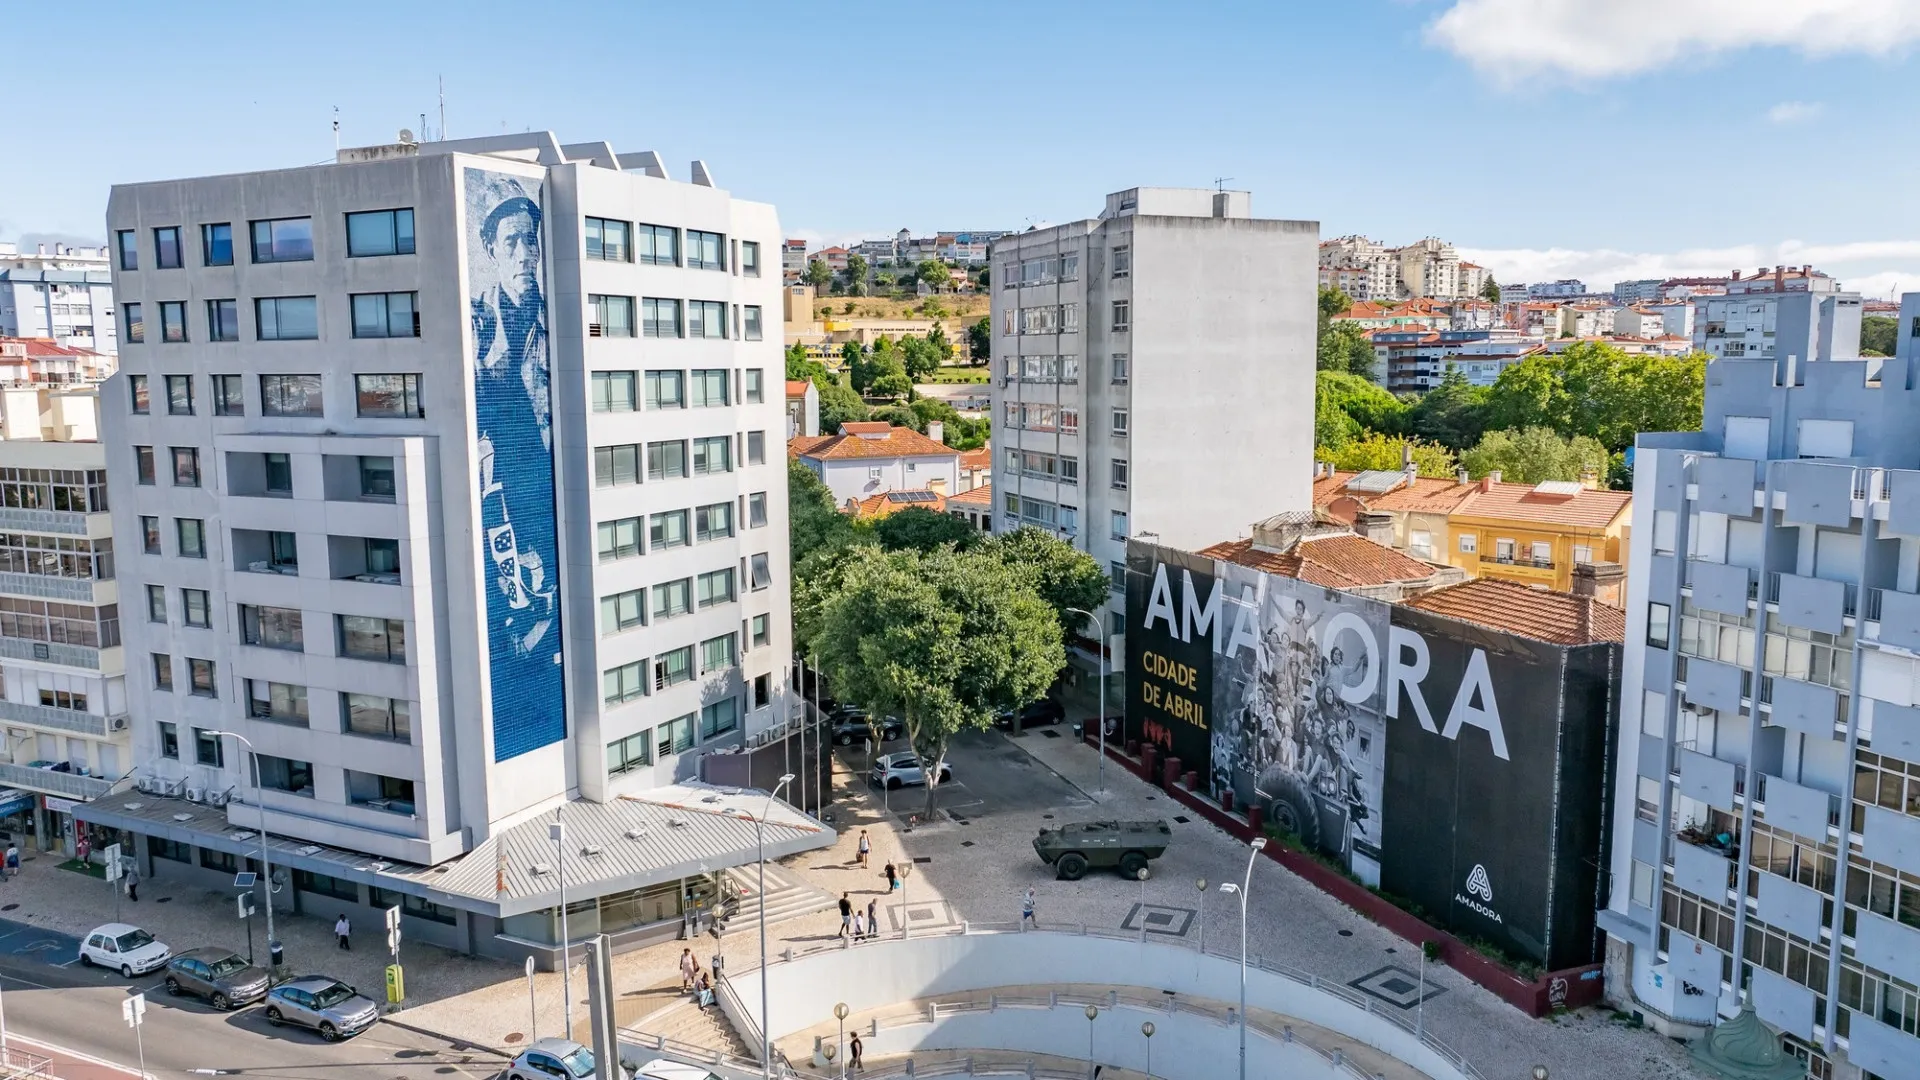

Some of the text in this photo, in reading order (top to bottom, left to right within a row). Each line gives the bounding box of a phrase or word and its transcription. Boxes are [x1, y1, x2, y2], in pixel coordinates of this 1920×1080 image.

[1143, 651, 1197, 692] CIDADE
[1144, 563, 1510, 761] AMAORA
[1143, 681, 1208, 729] DE ABRIL
[1455, 893, 1502, 924] AMADORA
